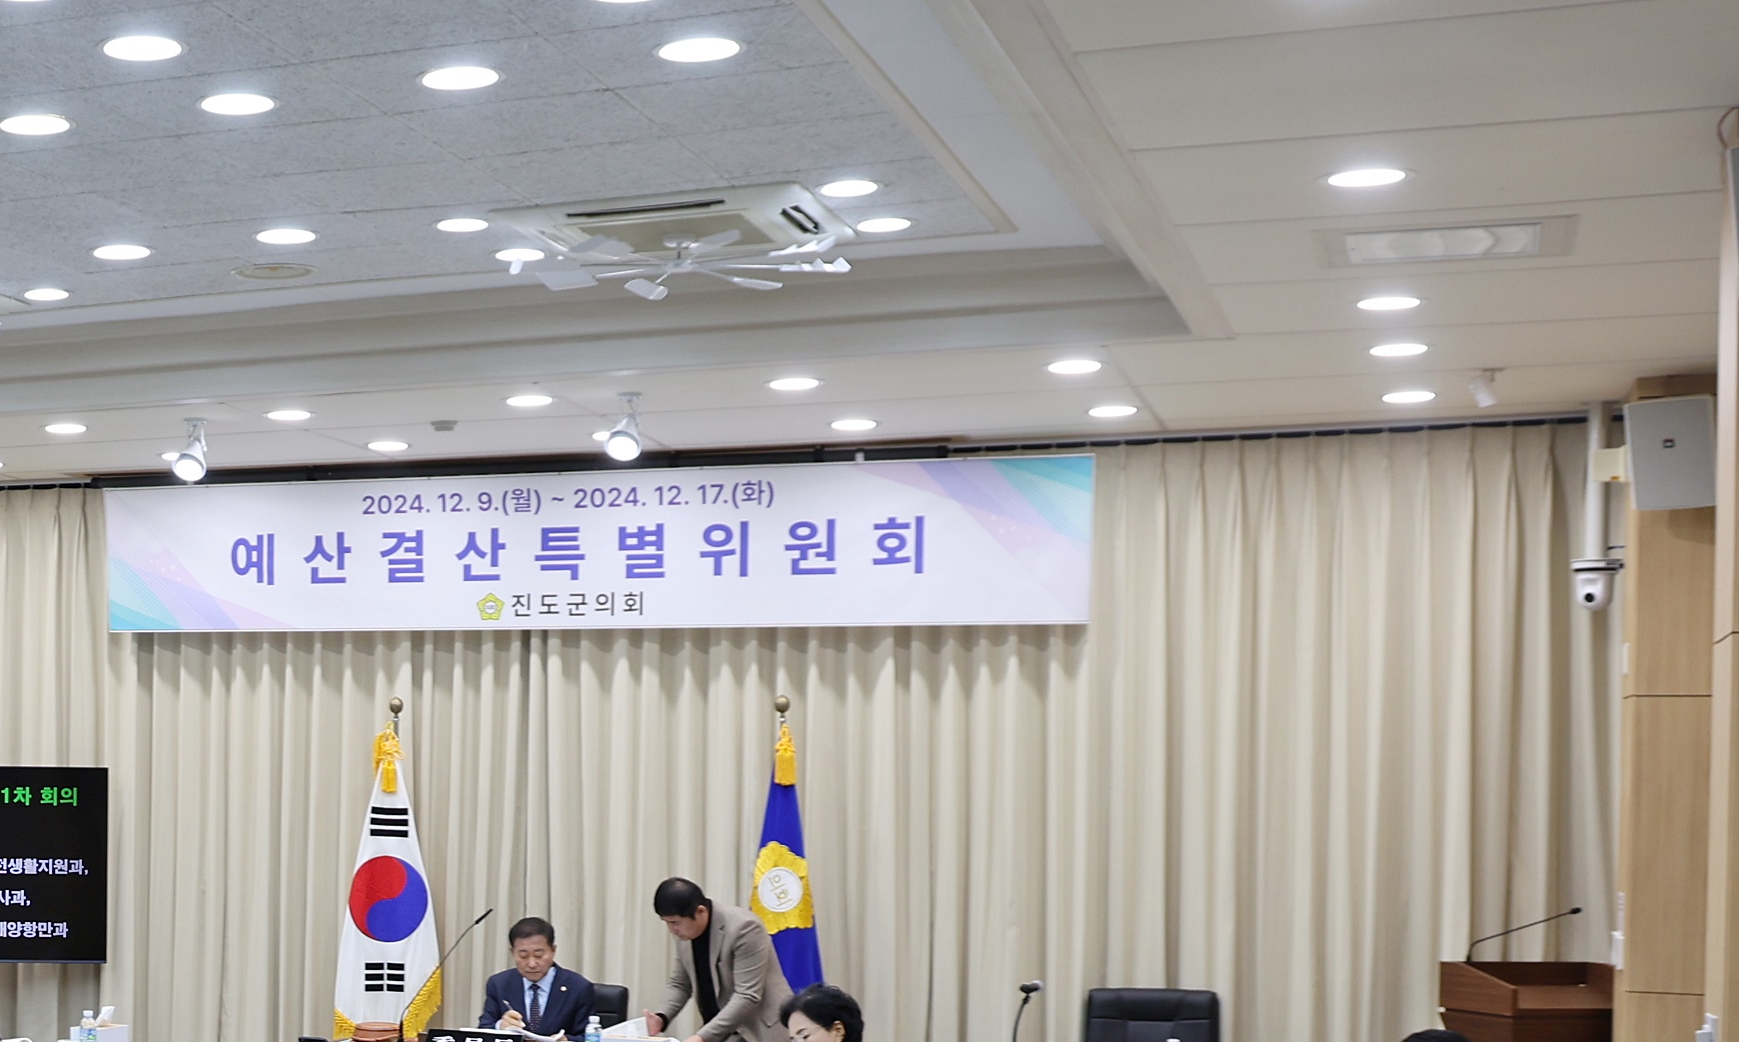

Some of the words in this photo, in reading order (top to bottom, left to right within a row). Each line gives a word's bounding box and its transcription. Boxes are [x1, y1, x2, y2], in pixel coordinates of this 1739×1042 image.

[362, 494, 431, 515] 2024.
[437, 492, 471, 513] 12.
[477, 487, 542, 516] 9.(월)
[573, 487, 647, 509] 2024.
[654, 485, 690, 506] 12.
[697, 480, 776, 509] 17.(화)
[511, 591, 645, 618] 진도군의회
[39, 786, 79, 806] 회의
